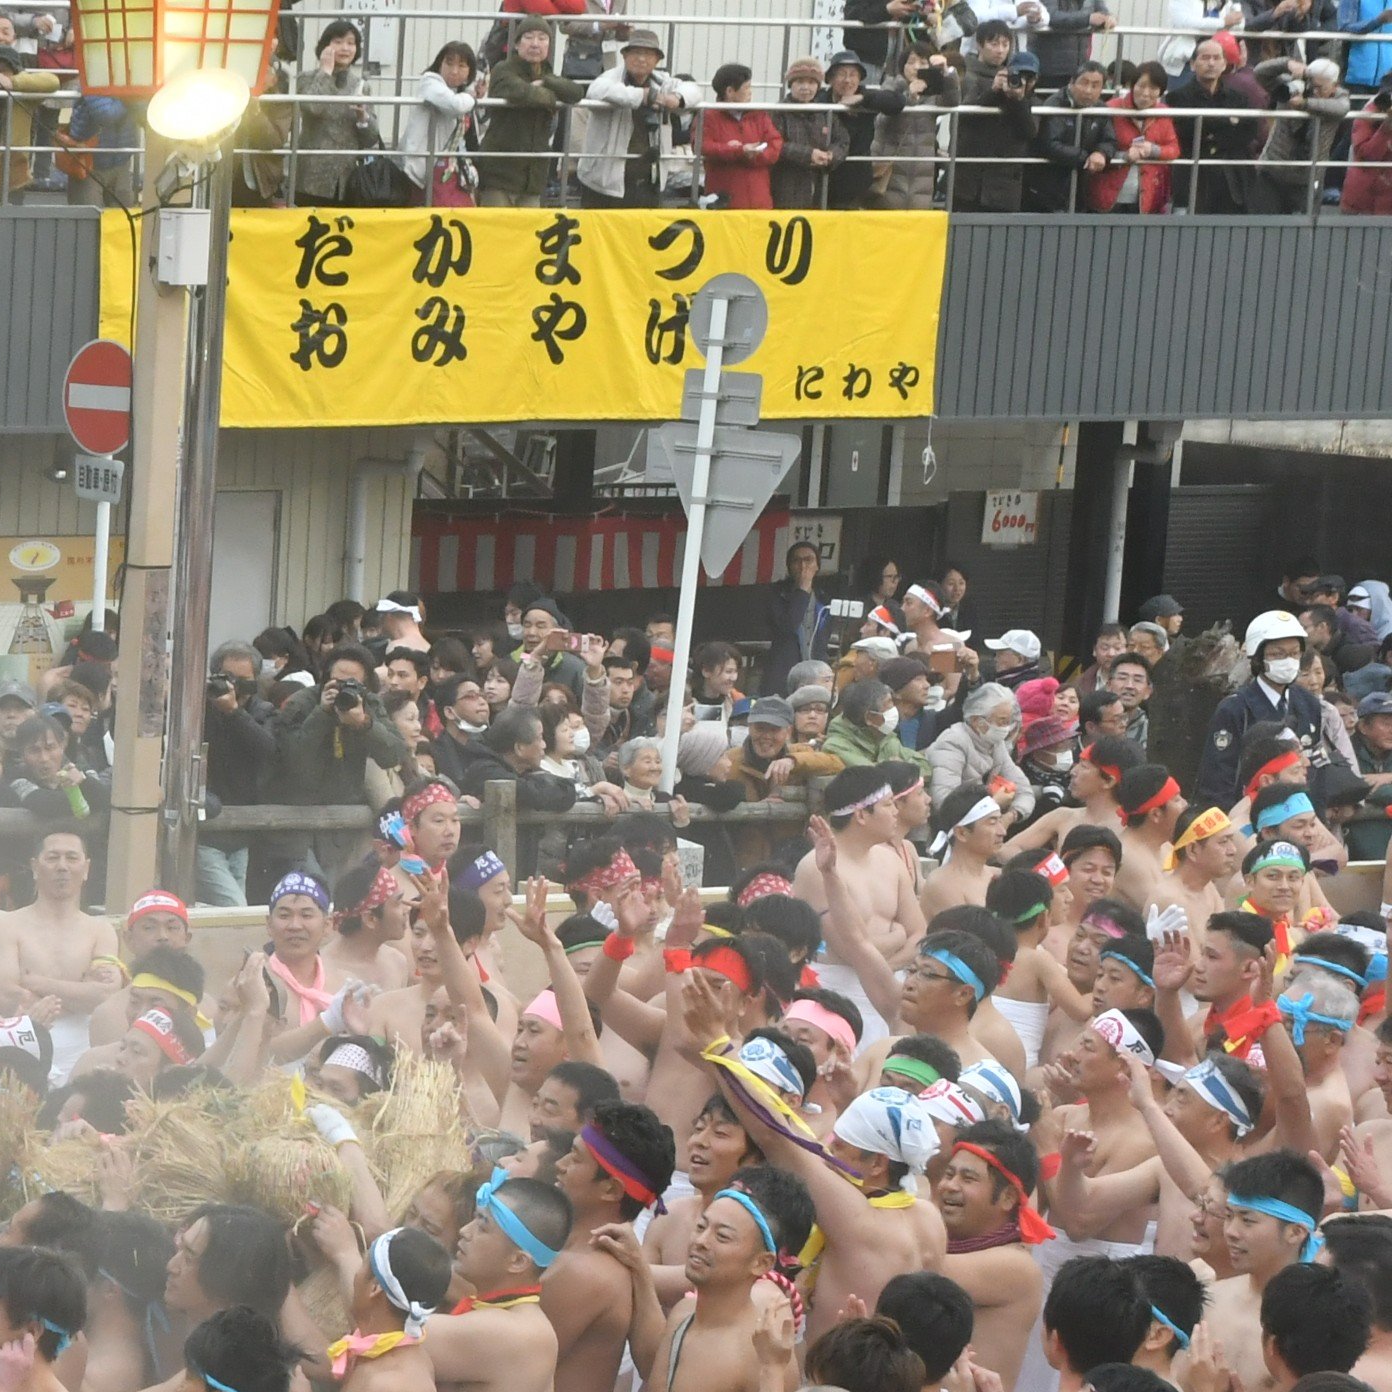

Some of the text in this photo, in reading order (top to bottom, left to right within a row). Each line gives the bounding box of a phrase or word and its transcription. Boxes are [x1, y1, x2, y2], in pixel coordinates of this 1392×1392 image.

[228, 213, 813, 288] だかまつり
[290, 293, 691, 372] おみやげ
[795, 363, 920, 401] にわや
[992, 510, 1037, 532] 6000円
[17, 1030, 35, 1046] 厄
[1126, 1039, 1147, 1055] 厄
